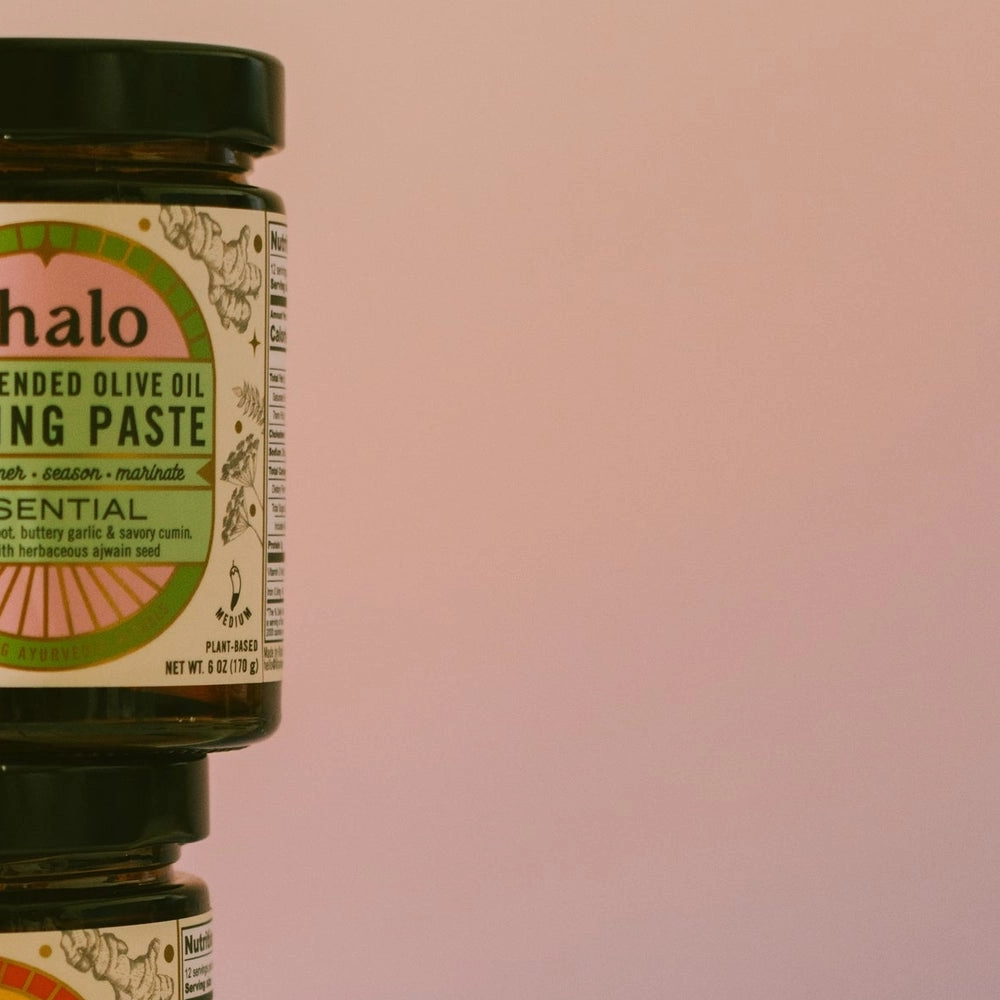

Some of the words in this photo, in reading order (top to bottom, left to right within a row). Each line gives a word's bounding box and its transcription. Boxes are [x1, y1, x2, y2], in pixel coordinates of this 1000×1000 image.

[93, 372, 163, 397] OLIVE
[172, 372, 205, 398] OIL
[90, 405, 207, 448] PASTE
[42, 466, 102, 482] season
[115, 463, 186, 482] marinate
[21, 526, 63, 542] buttery
[67, 526, 102, 542] garlic
[106, 526, 115, 539] &
[119, 528, 155, 542] savory
[19, 544, 88, 558] herbaceous
[93, 544, 131, 560] ajwain
[136, 544, 161, 558] seed
[215, 606, 252, 628] MEDIUM
[206, 639, 258, 653] PLANT-BASED
[165, 661, 185, 675] NET
[188, 660, 205, 675] WT.
[208, 660, 214, 674] 6
[216, 660, 227, 674] OZ
[230, 658, 247, 675] (170
[250, 658, 259, 676] g)
